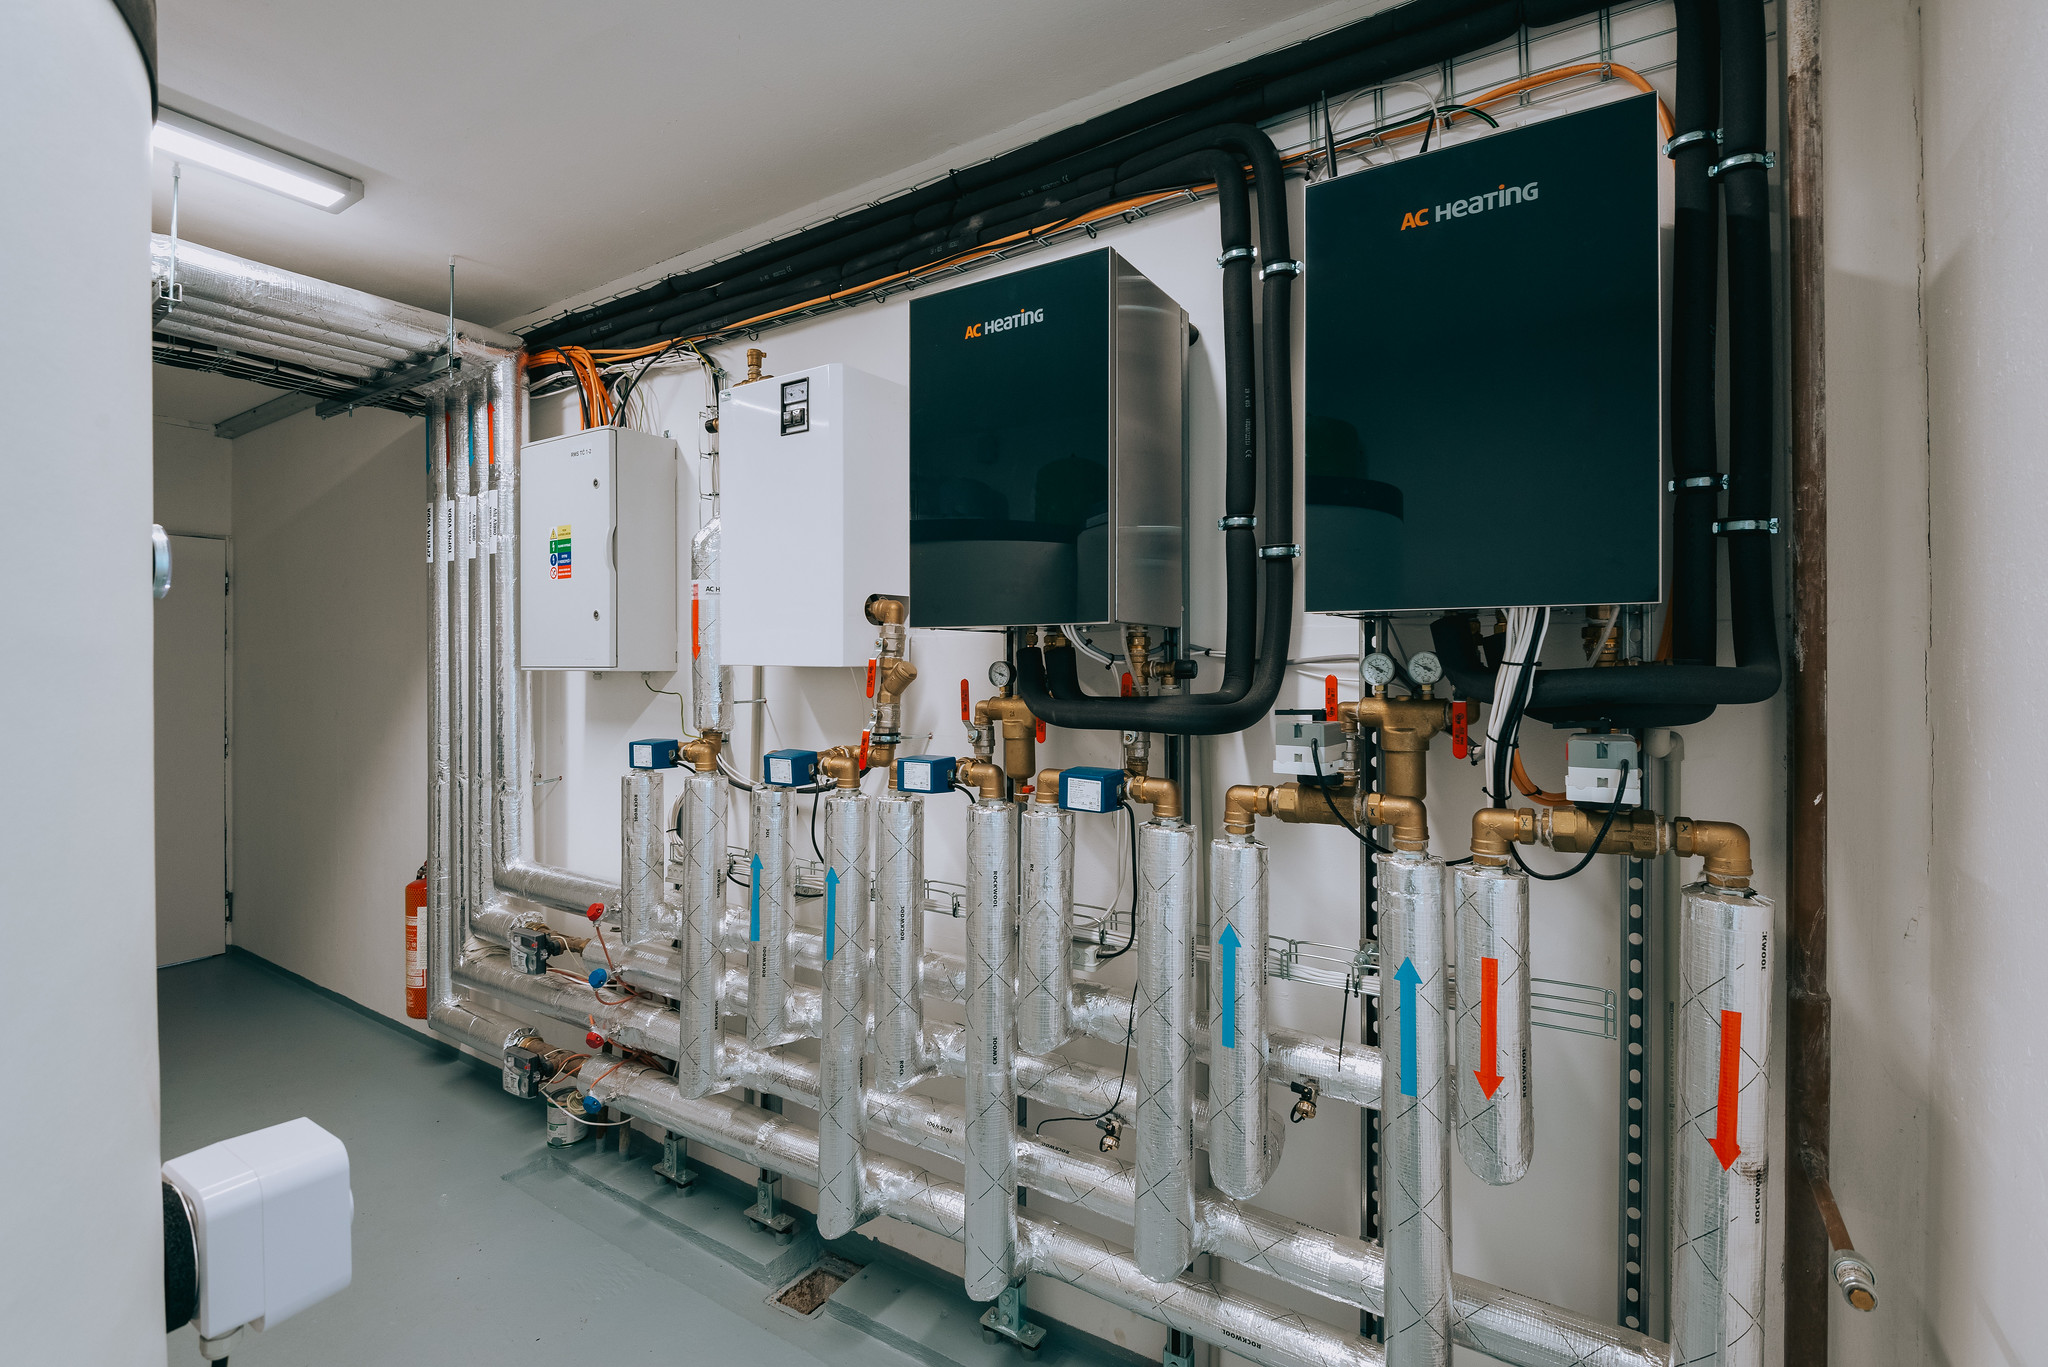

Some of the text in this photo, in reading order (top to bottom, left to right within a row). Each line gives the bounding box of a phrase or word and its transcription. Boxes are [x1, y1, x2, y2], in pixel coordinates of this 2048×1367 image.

[1400, 208, 1428, 230] AC
[964, 324, 982, 340] AC
[1222, 1329, 1262, 1350] ROCKWOOL
